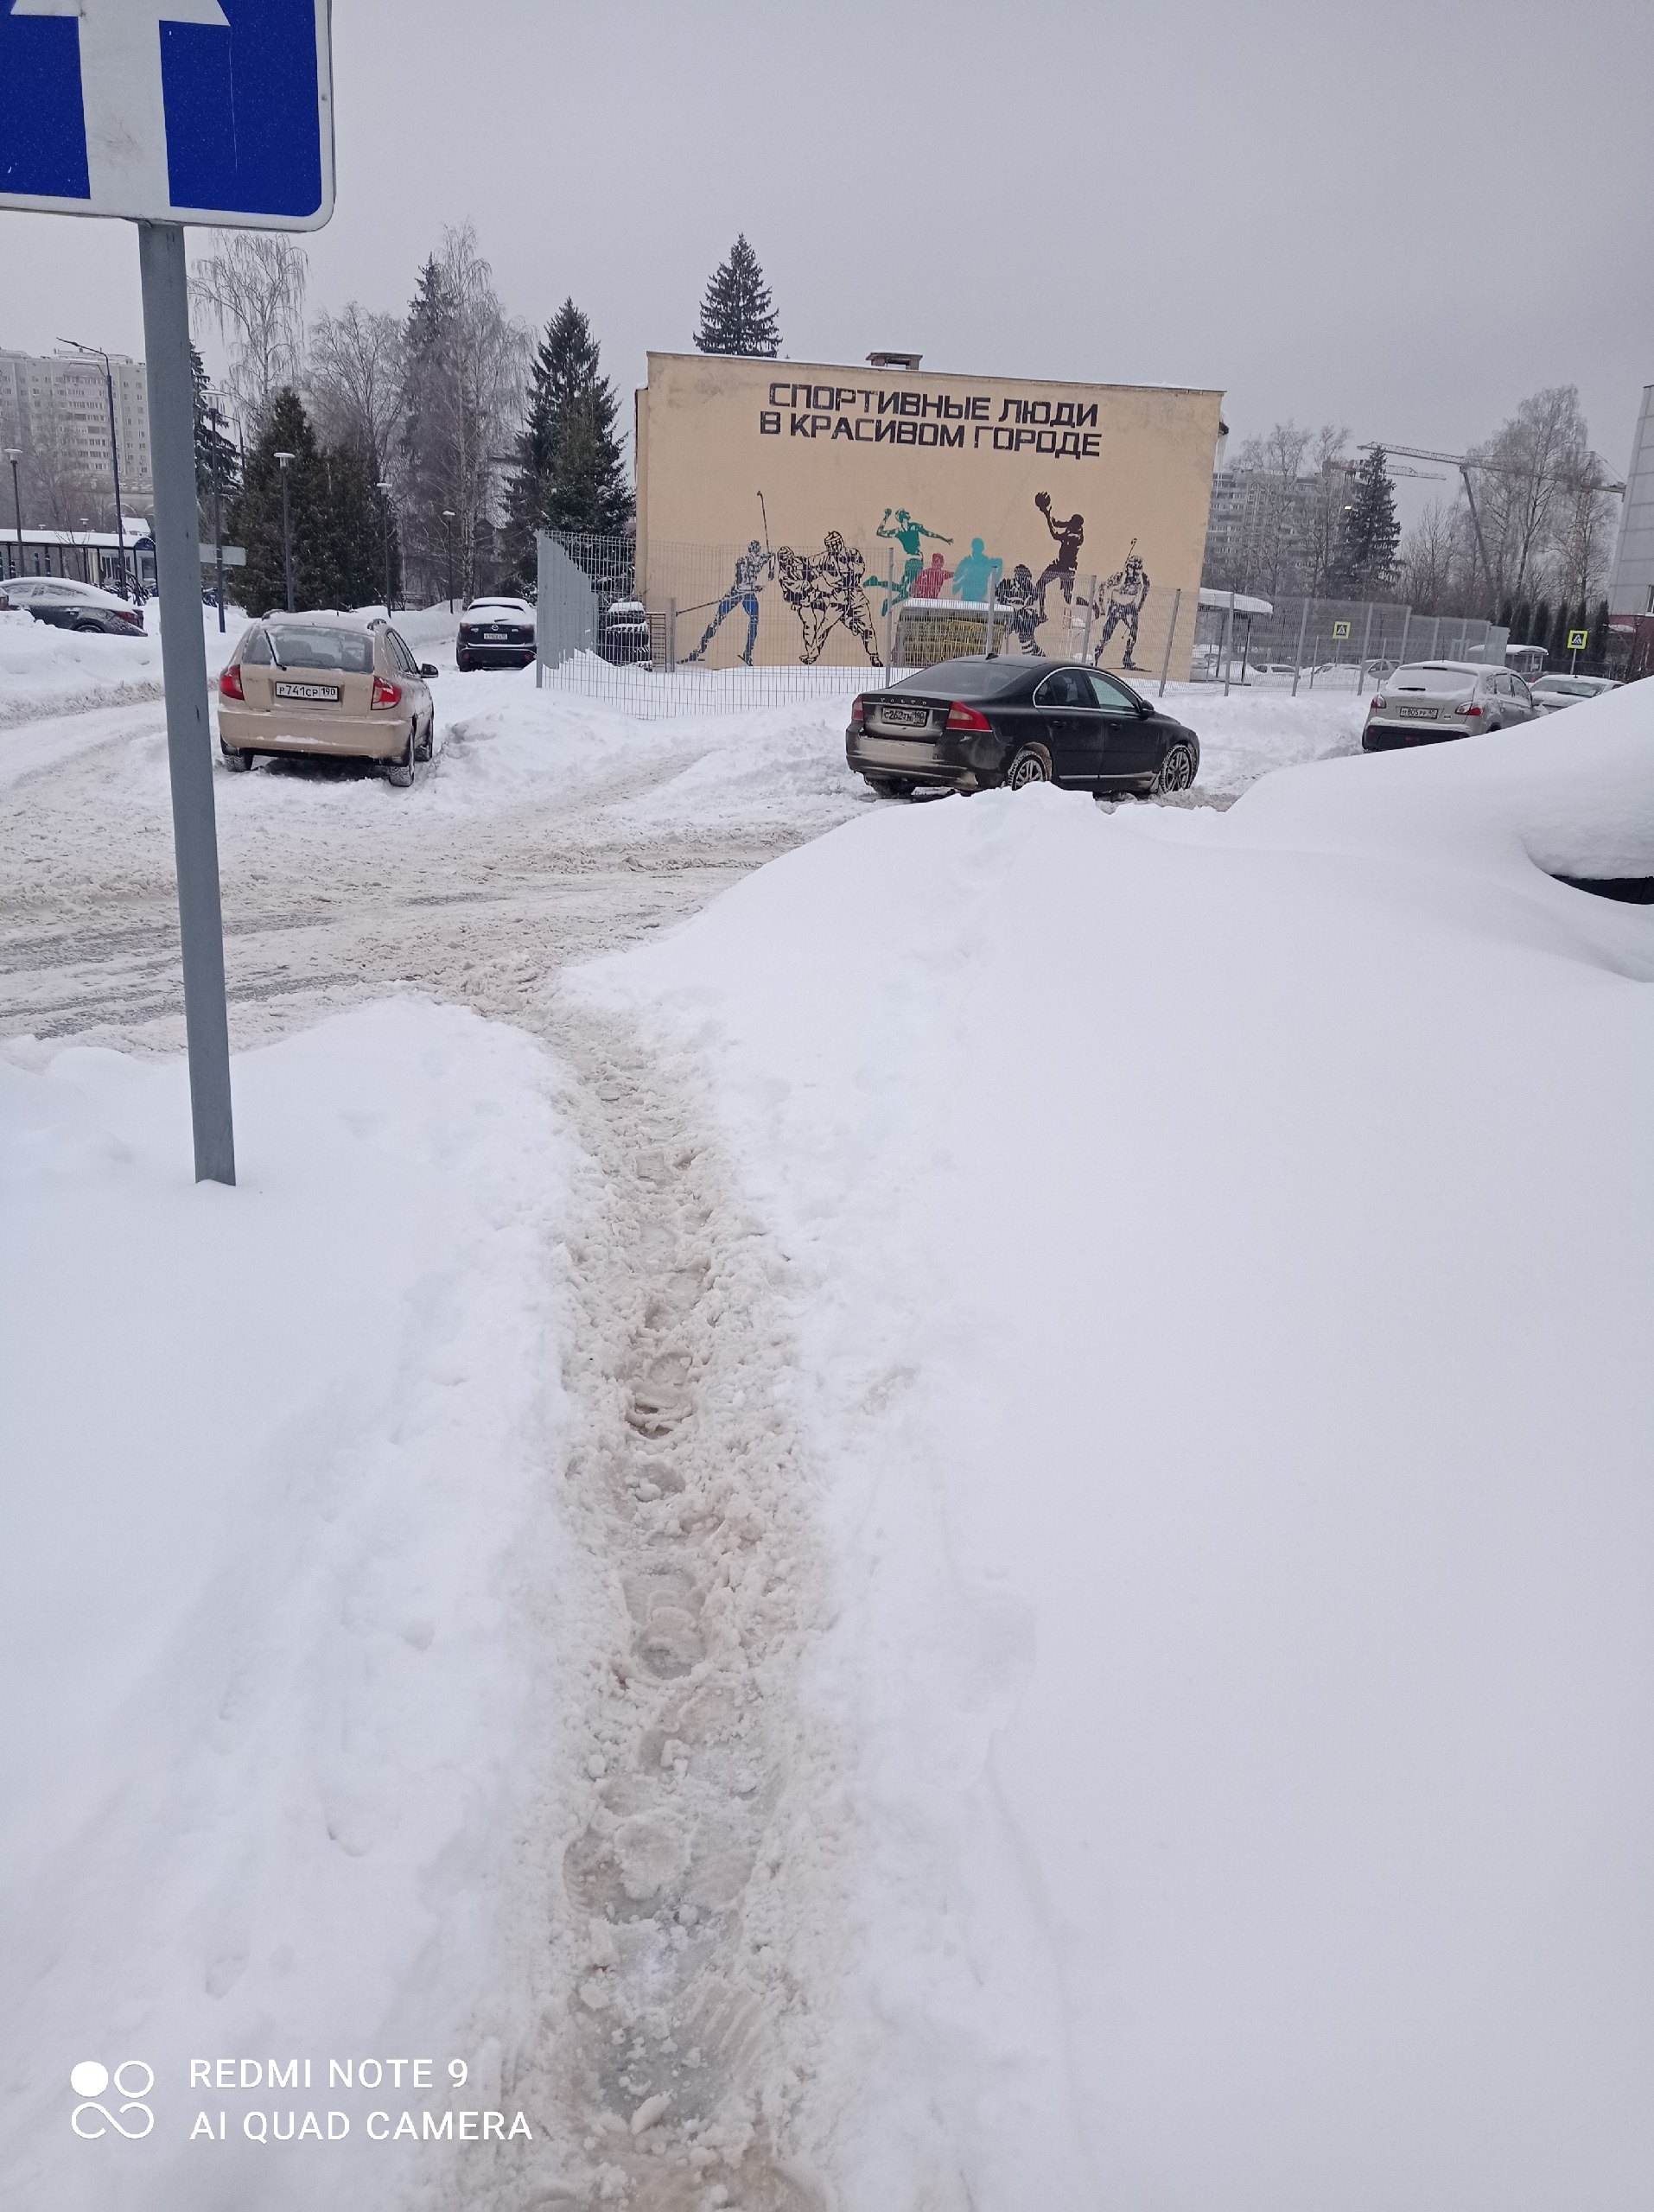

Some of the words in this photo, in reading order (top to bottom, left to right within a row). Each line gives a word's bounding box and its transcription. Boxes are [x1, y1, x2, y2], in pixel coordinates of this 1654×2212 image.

[769, 382, 991, 421] СПОРТИВНЫЕ
[998, 398, 1098, 429] ЛЮДИ
[760, 410, 781, 435] В
[790, 413, 965, 448] КРАСИВОМ
[974, 425, 1103, 461] ГОРОДЕ
